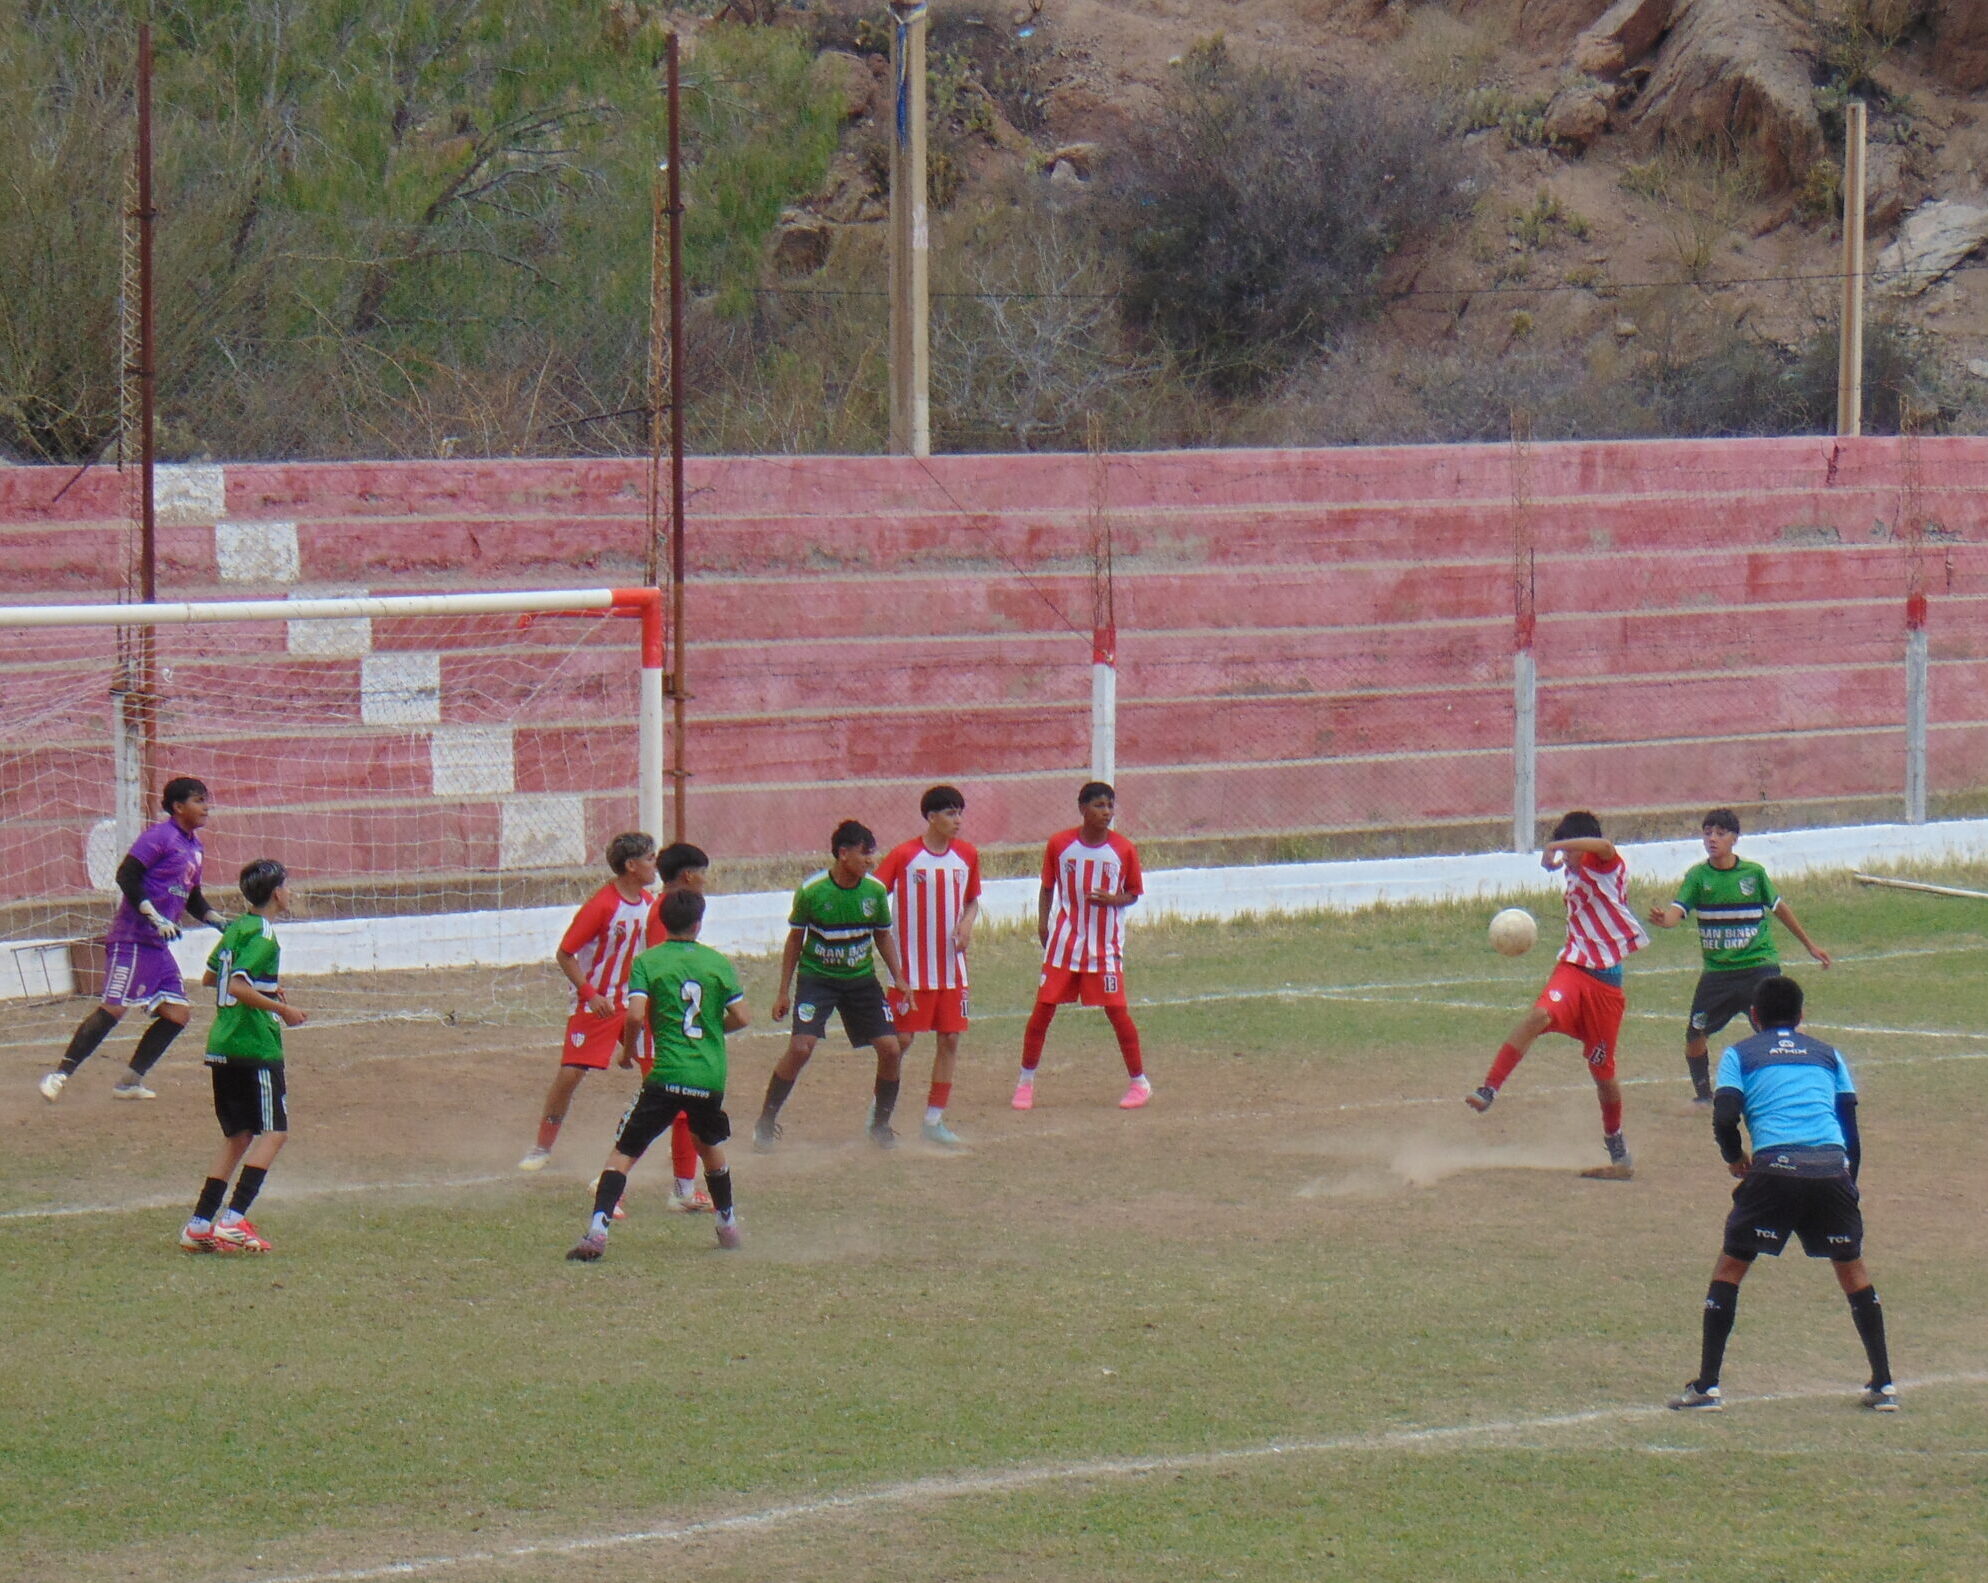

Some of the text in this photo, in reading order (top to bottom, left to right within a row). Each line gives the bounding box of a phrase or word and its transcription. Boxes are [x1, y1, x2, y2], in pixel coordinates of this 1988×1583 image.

[814, 943, 845, 958] GRAN
[107, 965, 131, 998] UNION
[1104, 975, 1118, 992] 13
[681, 980, 703, 1039] 2
[665, 1083, 680, 1094] LOS
[1754, 1228, 1778, 1240] TCL
[1827, 1236, 1852, 1244] TCL
